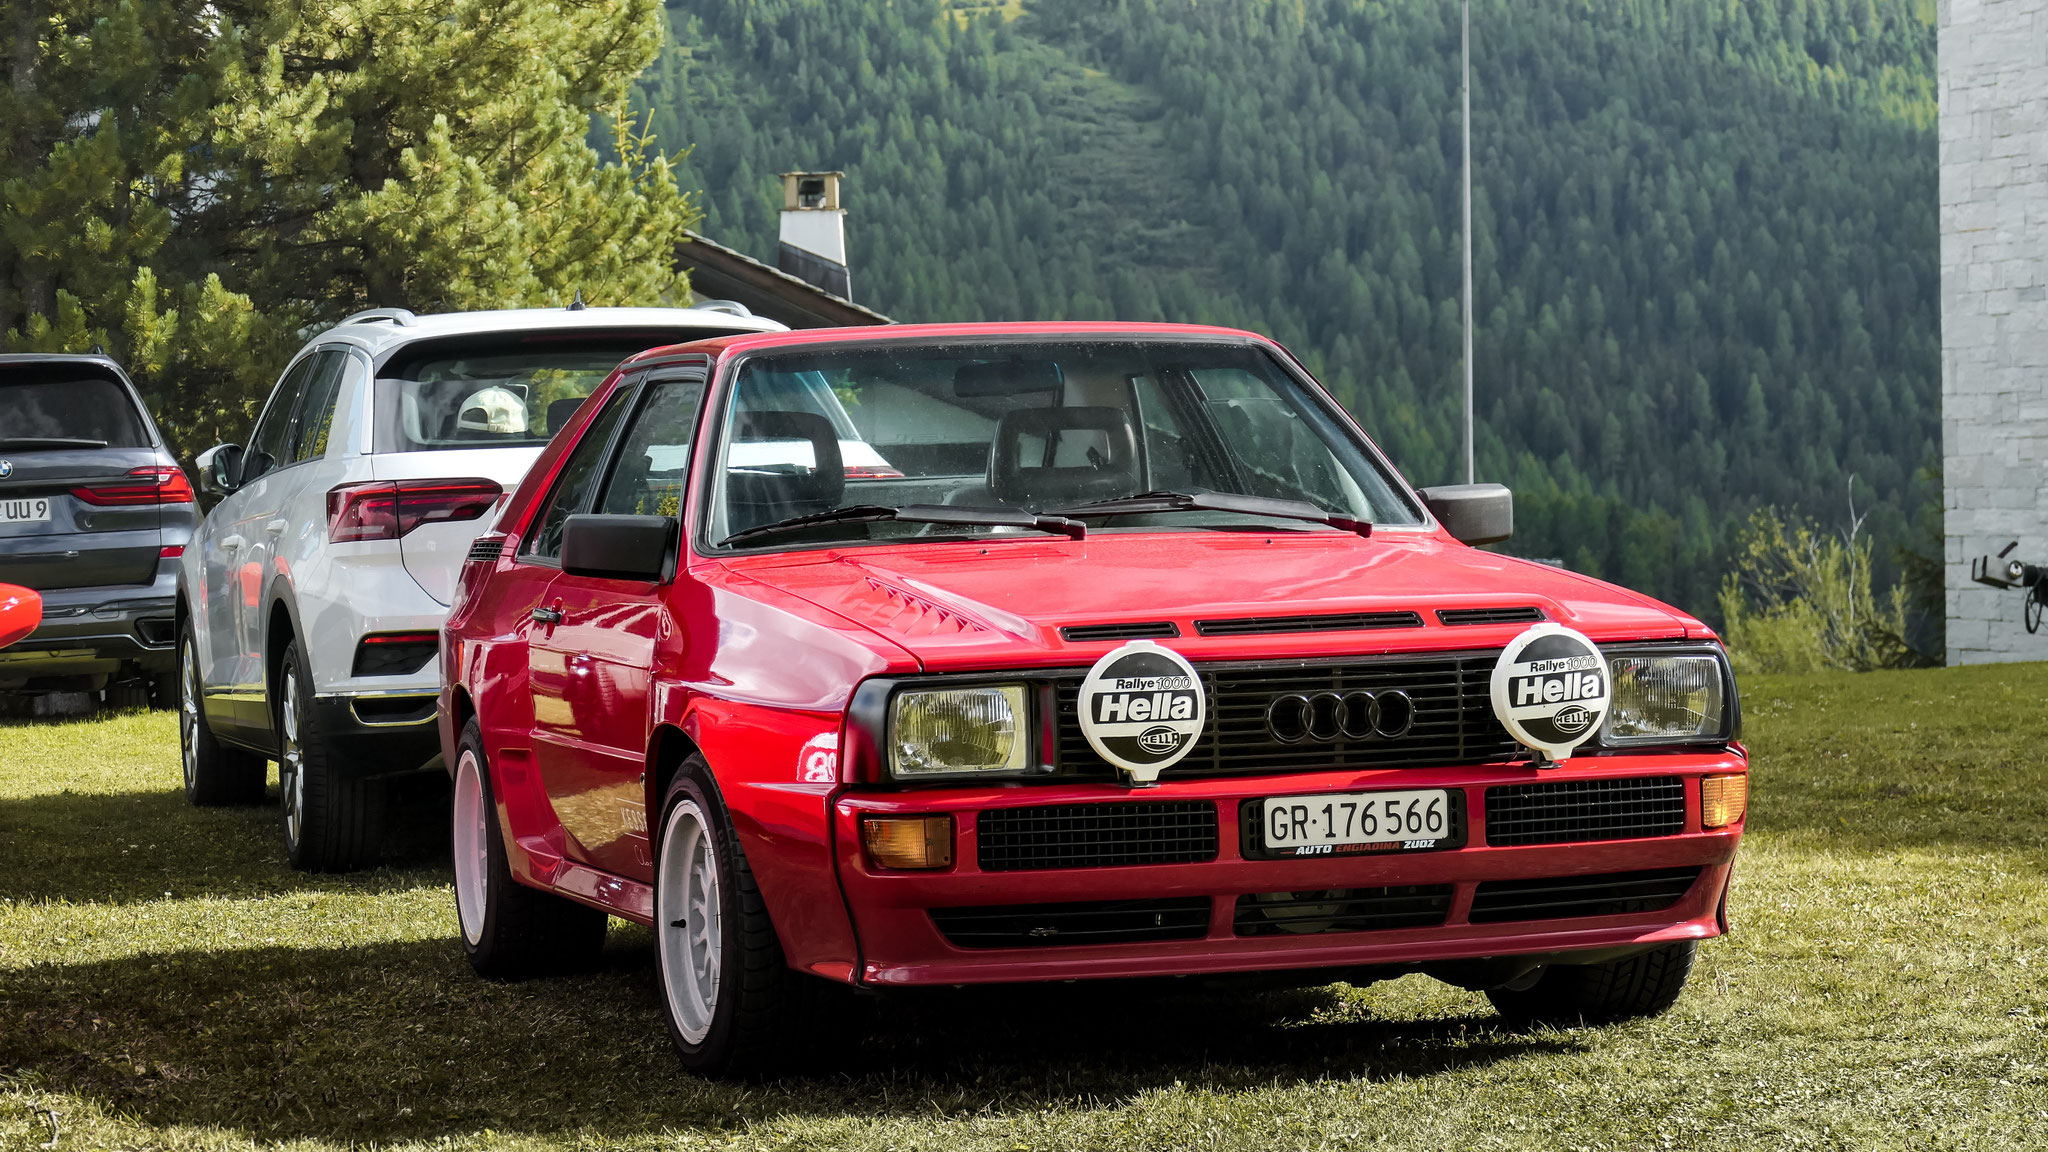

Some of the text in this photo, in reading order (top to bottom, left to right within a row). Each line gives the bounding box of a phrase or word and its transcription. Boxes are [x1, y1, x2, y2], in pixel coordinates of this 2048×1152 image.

[36, 500, 47, 518] 9
[1530, 655, 1597, 673] Rallye 1000
[1115, 676, 1192, 691] Rallye 1000
[1517, 672, 1599, 706] Hella
[1099, 692, 1193, 722] Hella
[1556, 710, 1590, 724] HELLA
[1141, 731, 1180, 745] HELLA
[1295, 839, 1436, 855] AUTO ENGIADINA ZUOZ
